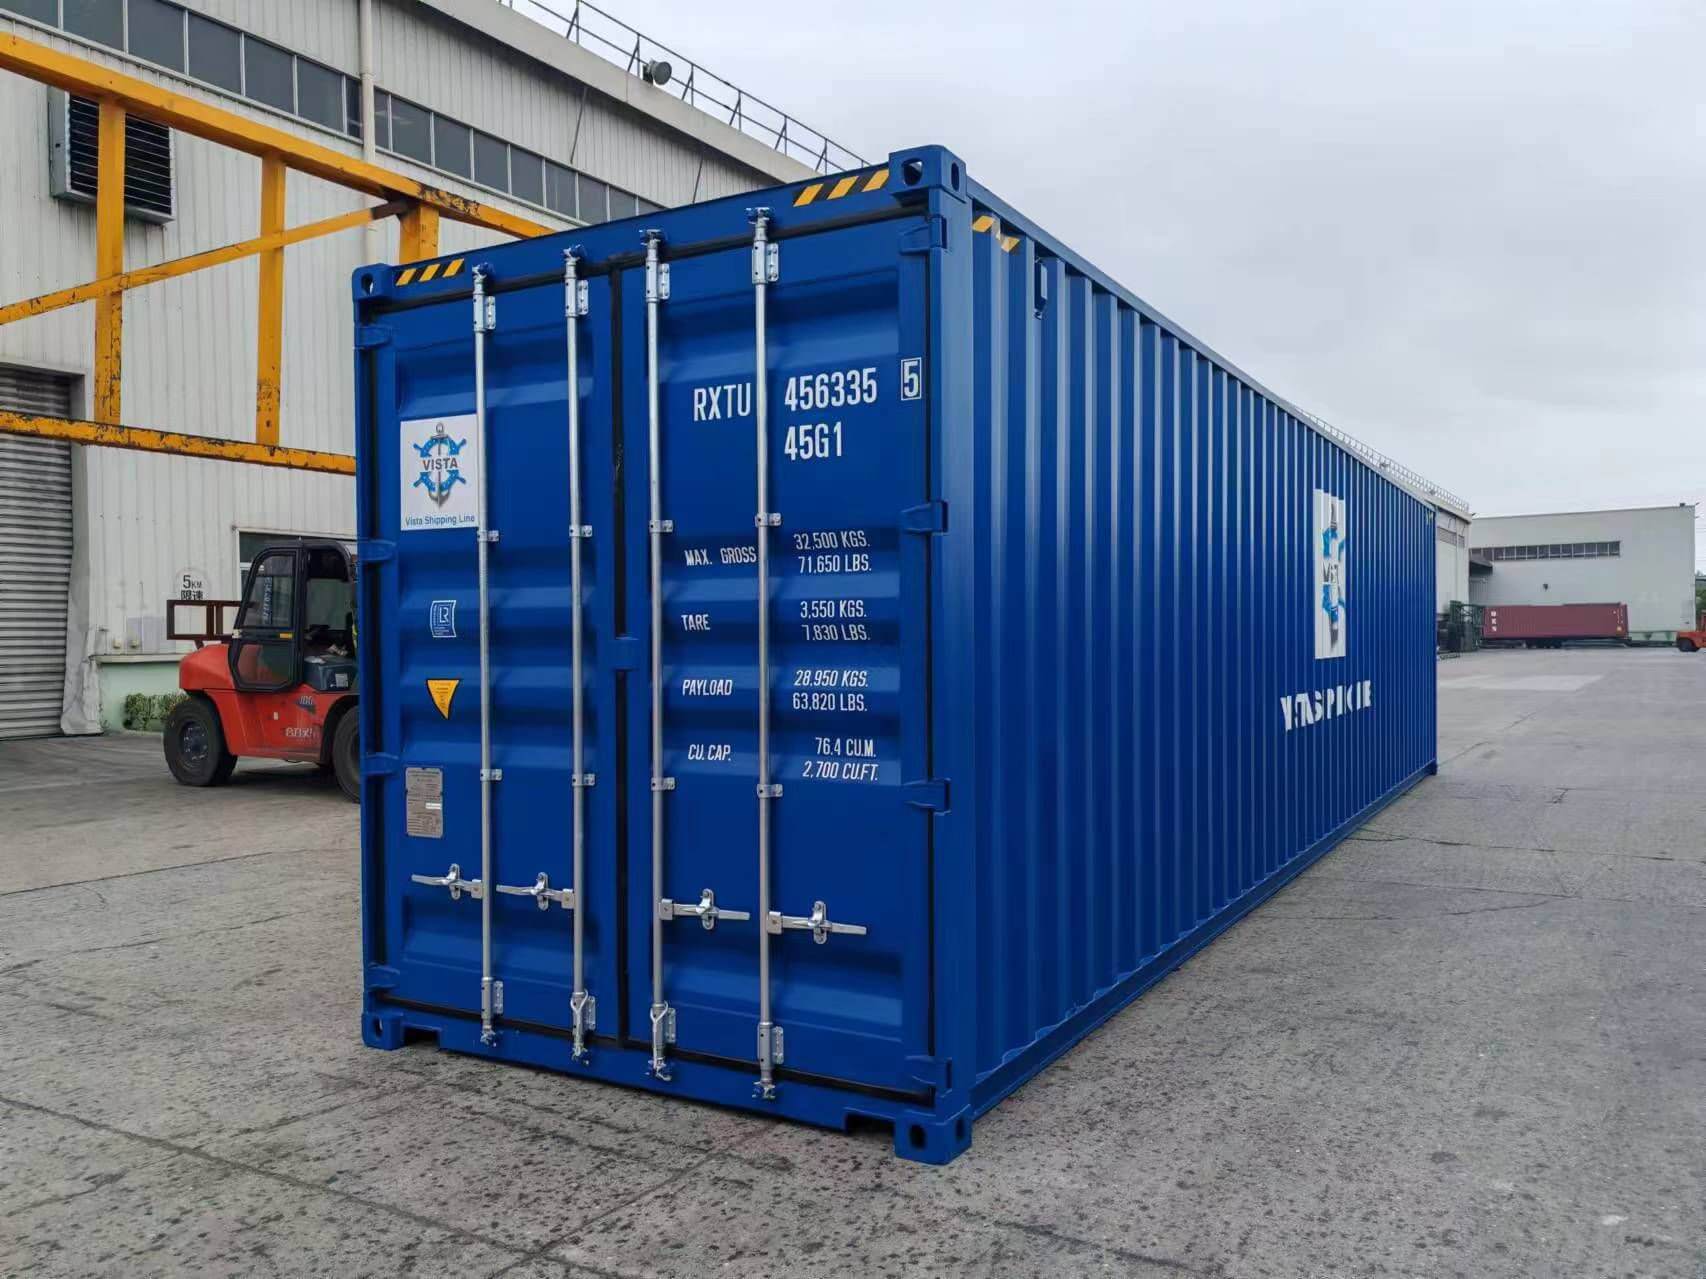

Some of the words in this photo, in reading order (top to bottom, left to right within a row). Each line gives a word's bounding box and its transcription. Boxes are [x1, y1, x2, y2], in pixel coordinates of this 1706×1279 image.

[693, 383, 751, 422] RXTU
[784, 367, 877, 412] 456335
[903, 360, 920, 398] 5
[784, 421, 843, 461] 45G1
[422, 457, 459, 471] VISTA
[405, 514, 423, 526] Vista
[424, 514, 457, 525] Shipping
[459, 513, 475, 523] Line
[840, 530, 871, 548] KGS.
[684, 549, 713, 566] MAX.
[720, 546, 757, 564] GROSS
[844, 553, 872, 573] LBS.
[839, 599, 867, 618] KGS.
[681, 614, 711, 631] TARE
[840, 624, 871, 641] LBS.
[682, 679, 733, 696] PAYLOAD
[841, 669, 869, 688] KGS.
[839, 693, 868, 712] LBS.
[815, 737, 841, 756] 76.4
